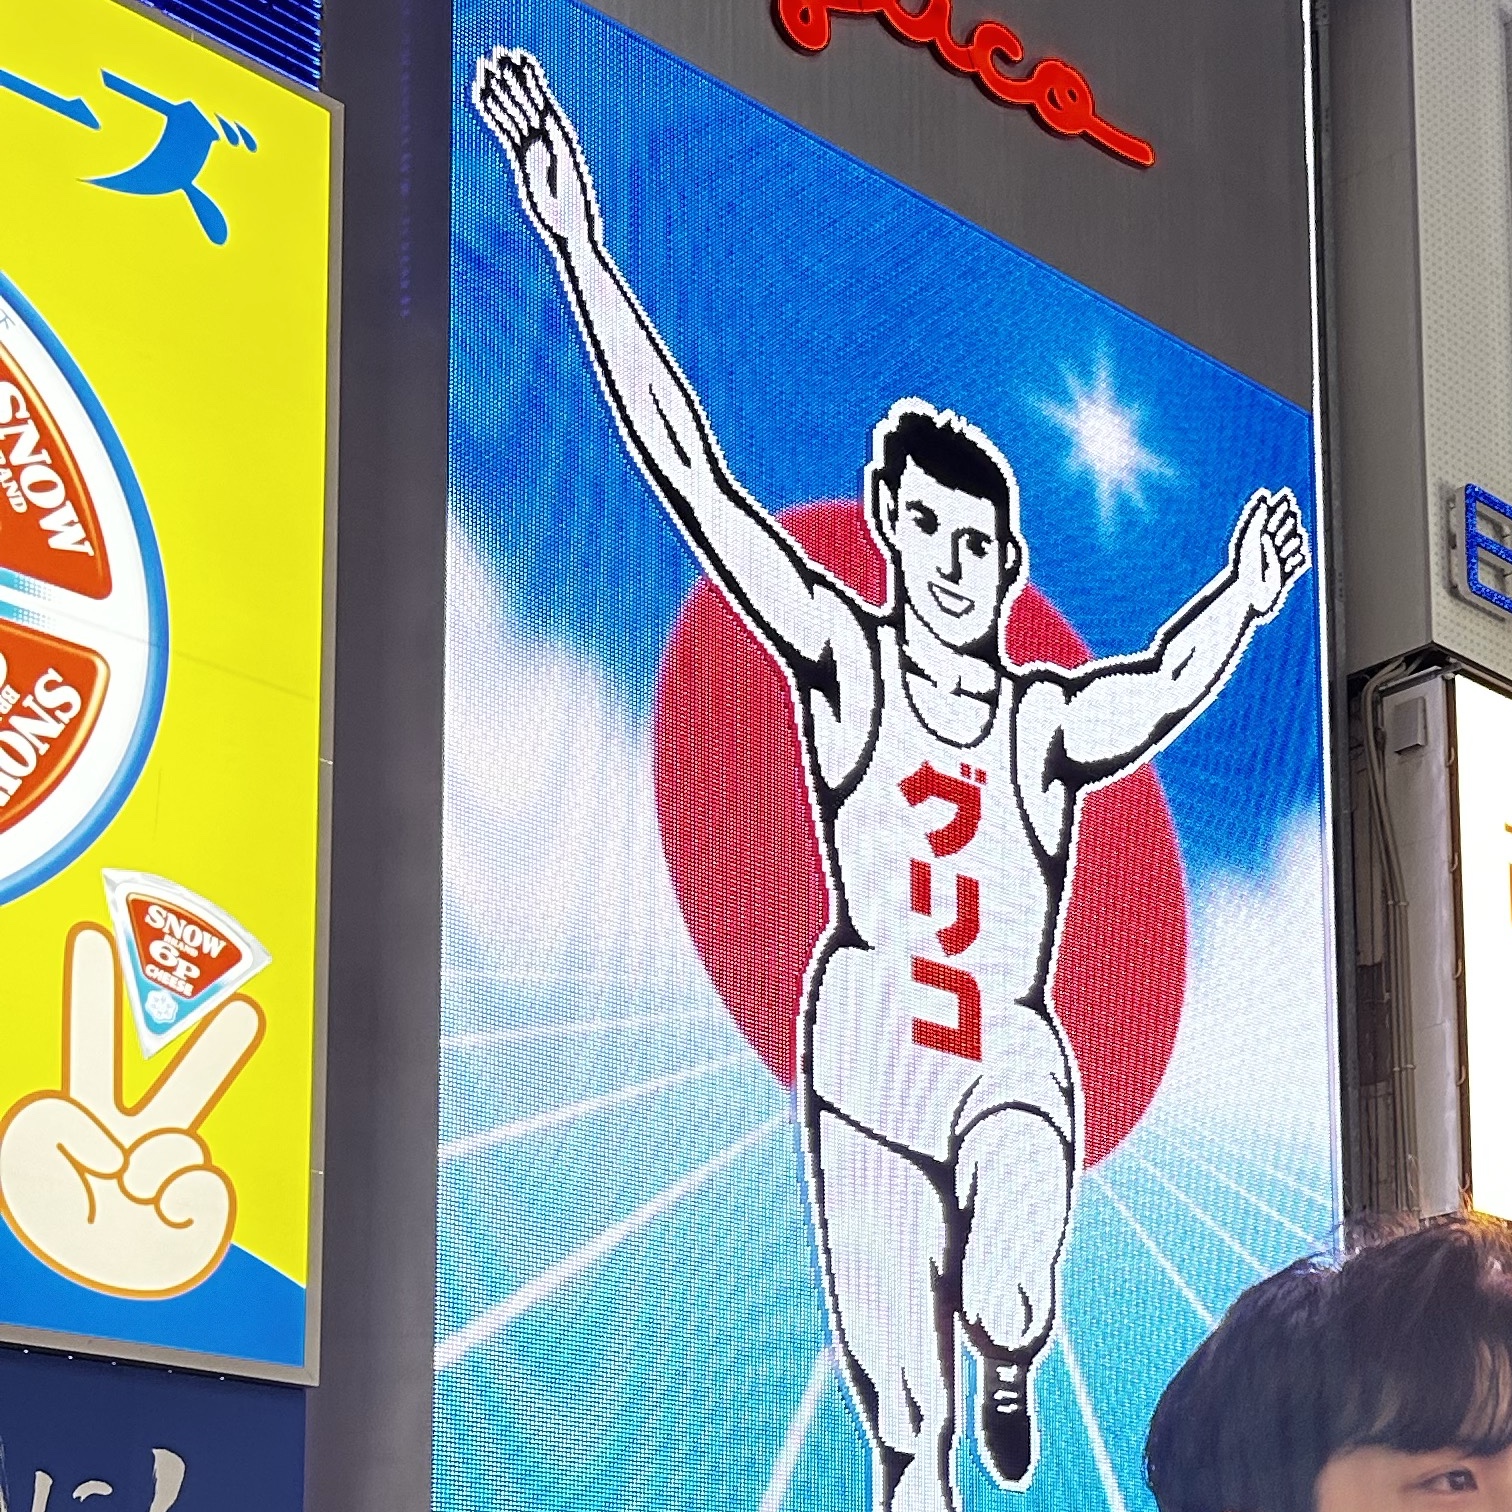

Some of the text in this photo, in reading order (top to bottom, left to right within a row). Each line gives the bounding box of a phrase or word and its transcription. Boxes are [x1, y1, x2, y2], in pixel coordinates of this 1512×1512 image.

[144, 904, 227, 959] SNOW
[898, 759, 987, 1064] グリコ
[148, 939, 201, 979] 6P
